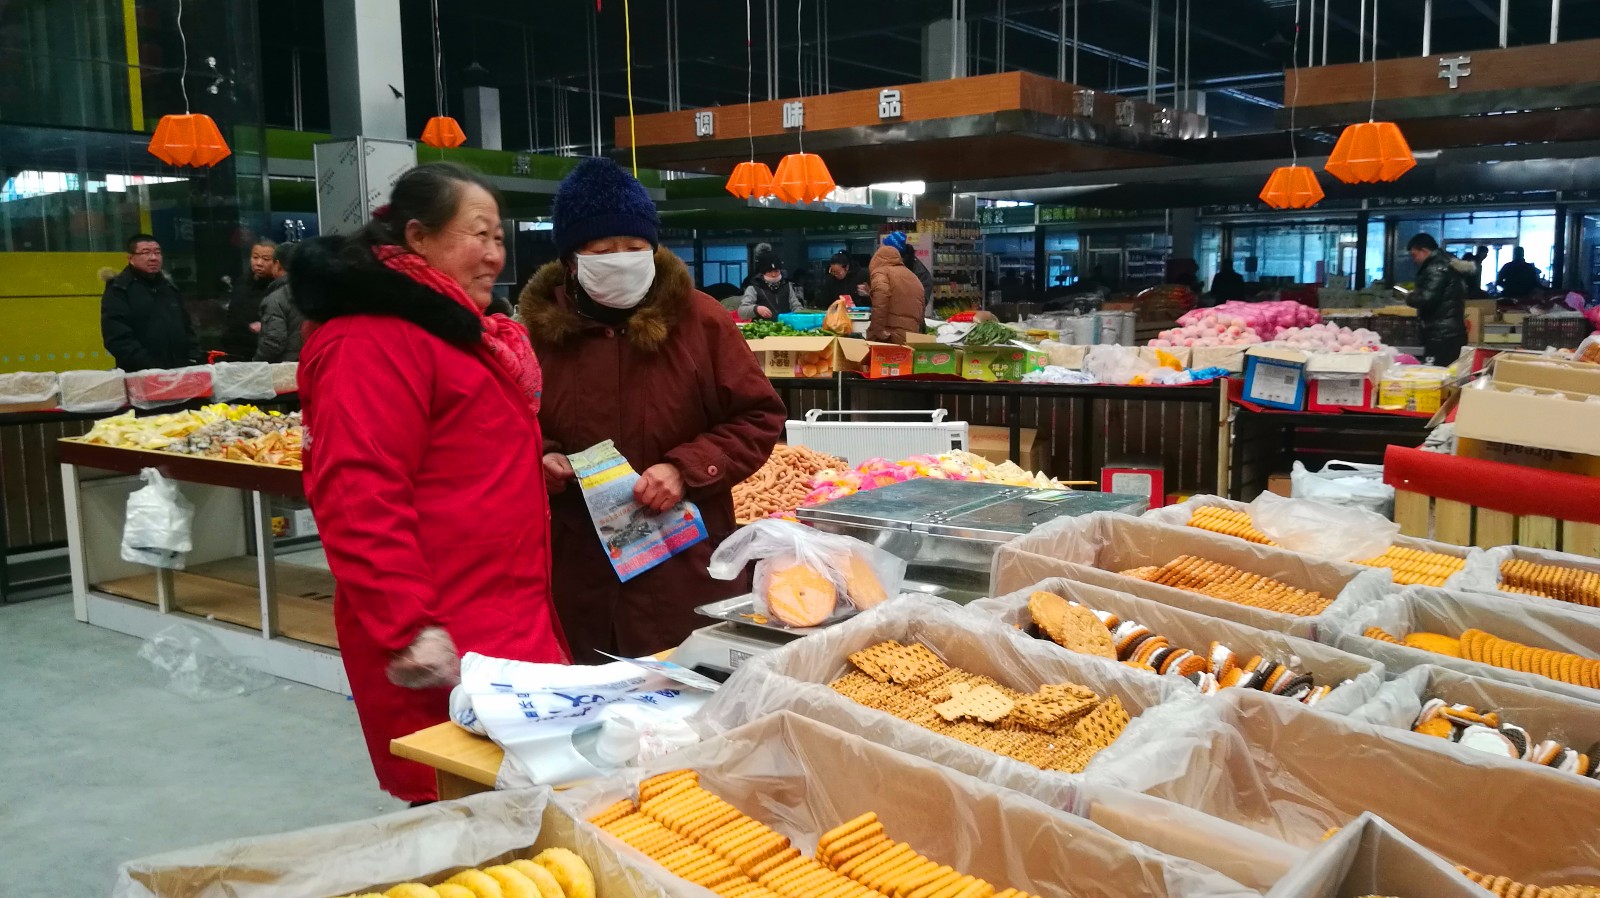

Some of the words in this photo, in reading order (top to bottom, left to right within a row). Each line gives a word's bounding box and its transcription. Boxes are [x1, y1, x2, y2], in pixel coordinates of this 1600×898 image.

[1438, 56, 1471, 88] 干
[695, 89, 901, 136] 调味品
